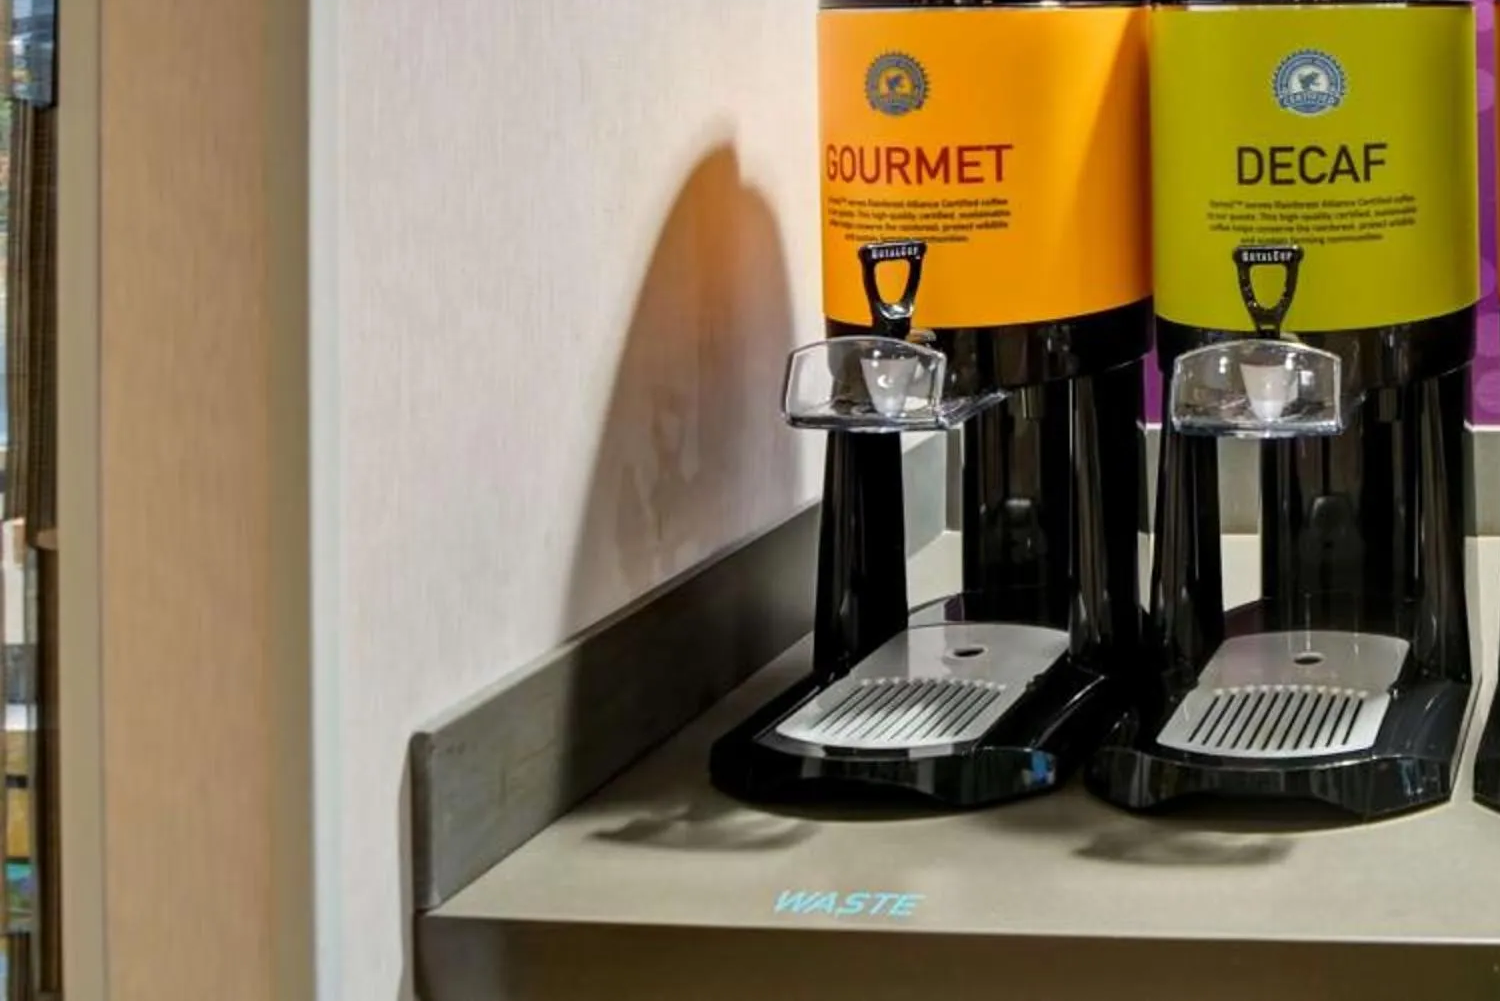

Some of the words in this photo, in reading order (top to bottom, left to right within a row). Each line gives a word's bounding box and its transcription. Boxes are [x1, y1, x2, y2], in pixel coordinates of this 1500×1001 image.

[826, 144, 1014, 185] GOURMET
[1236, 143, 1388, 186] DECAF
[774, 890, 928, 917] WASTE
